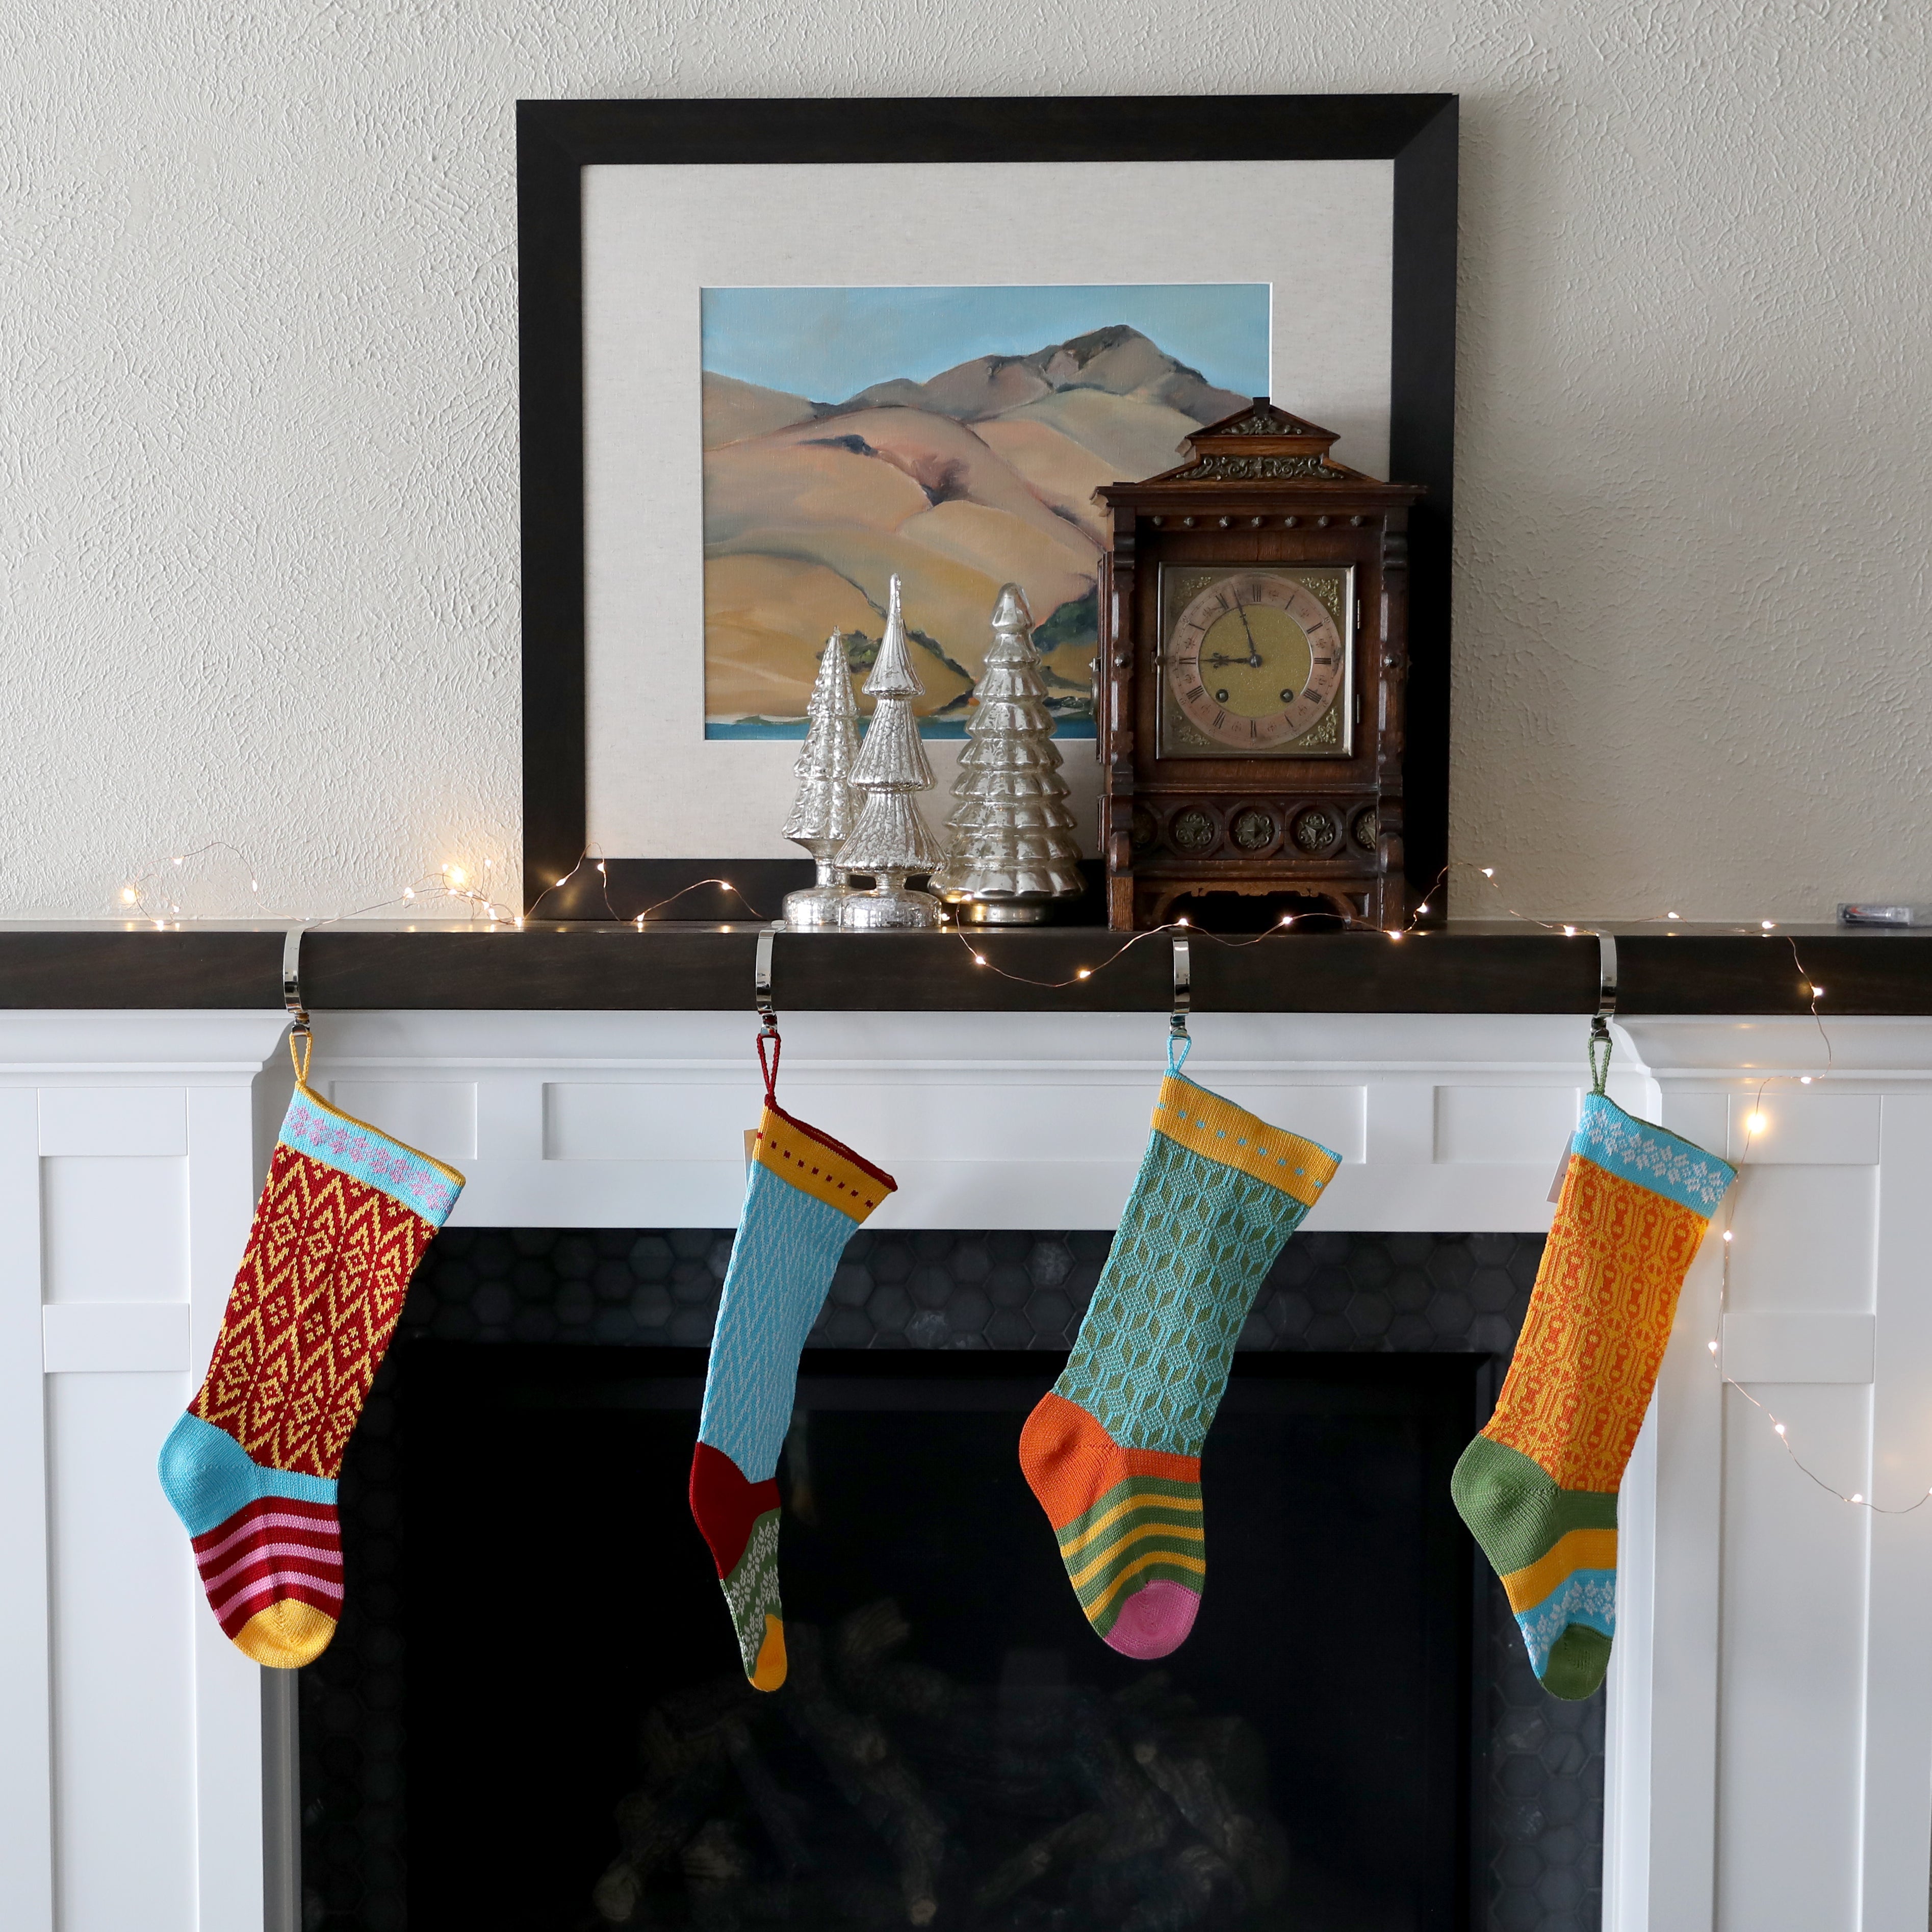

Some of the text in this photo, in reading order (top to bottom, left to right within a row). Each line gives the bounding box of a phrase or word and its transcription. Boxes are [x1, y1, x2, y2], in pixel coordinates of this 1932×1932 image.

[1284, 594, 1296, 610] I
[1306, 622, 1324, 634] II
[1303, 688, 1323, 705] IIII
